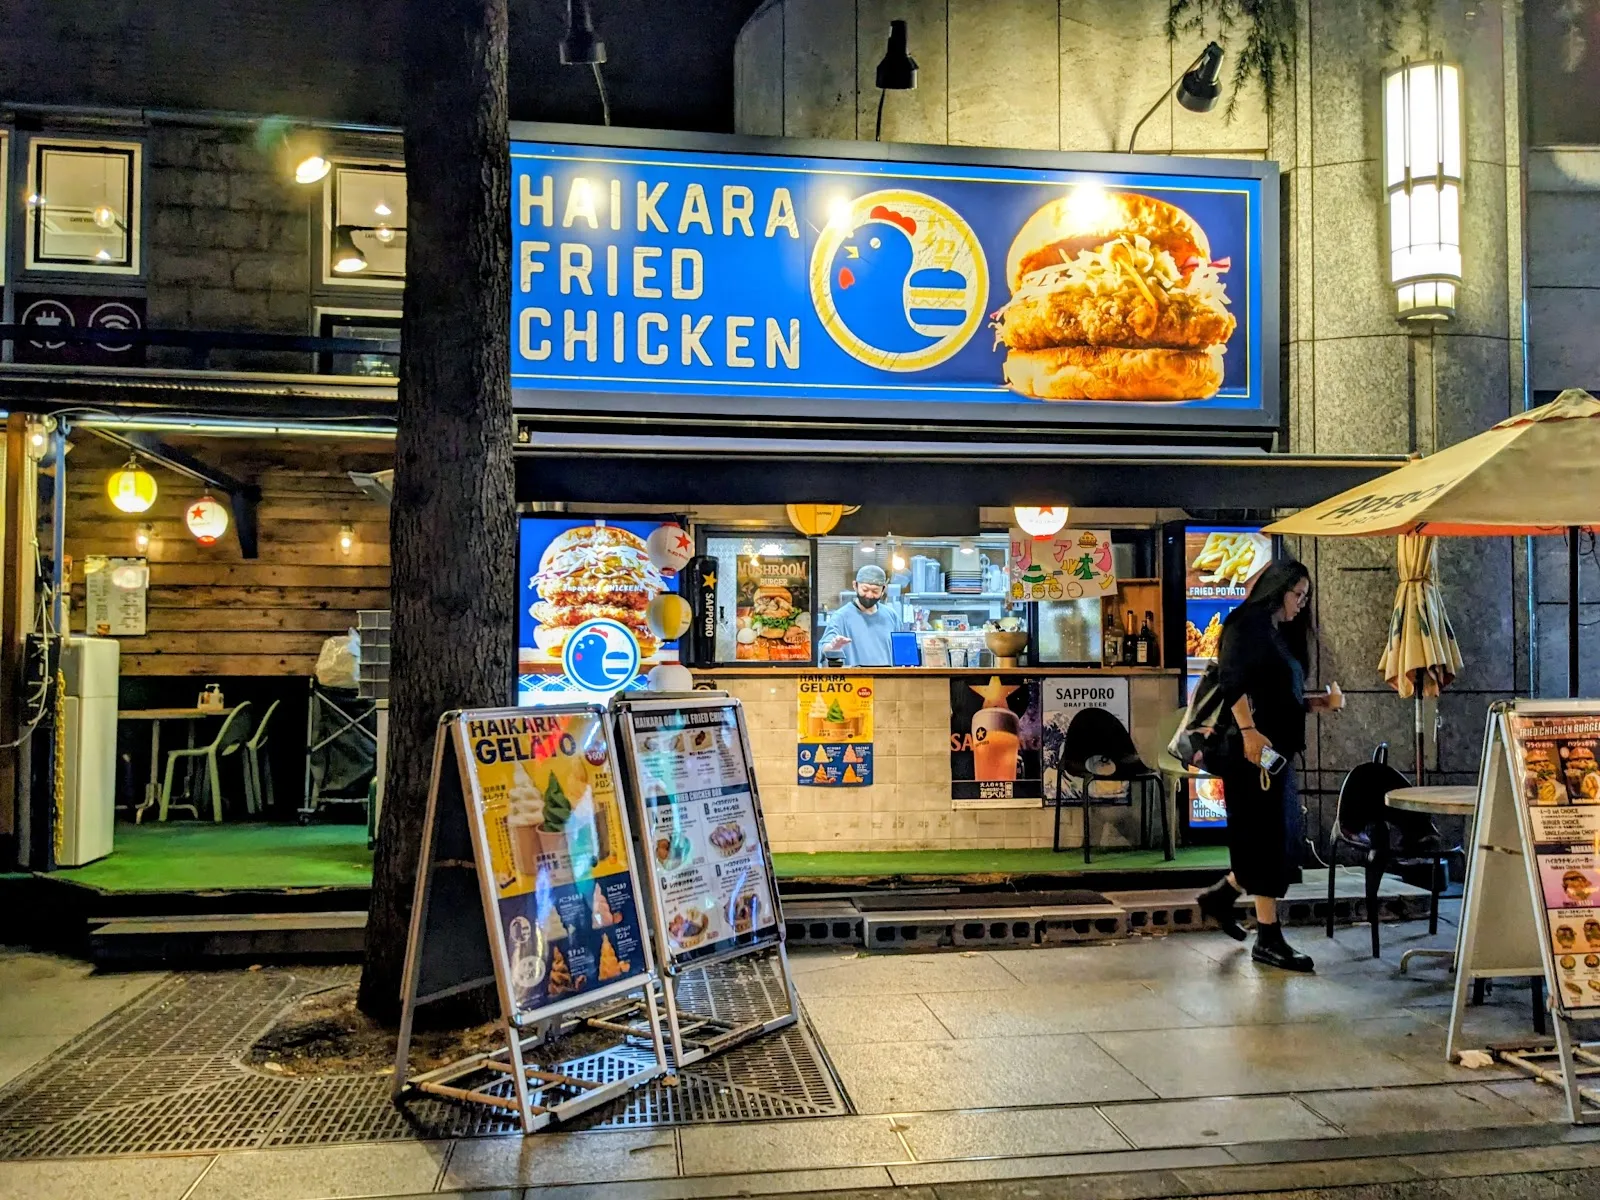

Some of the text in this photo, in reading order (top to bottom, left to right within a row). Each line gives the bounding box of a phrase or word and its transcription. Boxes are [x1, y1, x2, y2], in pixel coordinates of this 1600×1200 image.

[519, 174, 800, 239] HAIKARA
[519, 240, 704, 300] FRIED
[519, 306, 800, 370] CHICKEN
[738, 561, 807, 580] MUSHROOM
[760, 578, 788, 586] BURGER
[1189, 587, 1246, 596] FRIED POTATO
[705, 592, 714, 638] SAPPORO
[800, 674, 846, 682] HAIKARA
[800, 682, 853, 693] GELATO
[1056, 687, 1115, 700] SAPPORO
[470, 715, 561, 738] HAIKARA
[634, 715, 663, 729] HAIKARA
[690, 712, 709, 724] FRIED
[1520, 728, 1538, 738] FRIED
[1539, 724, 1573, 736] CHICKEN
[475, 733, 576, 765] GELATO
[689, 790, 711, 801] CHICKEN
[711, 788, 723, 797] BOX
[703, 802, 710, 815] B
[715, 864, 722, 877] D
[660, 876, 668, 890] C
